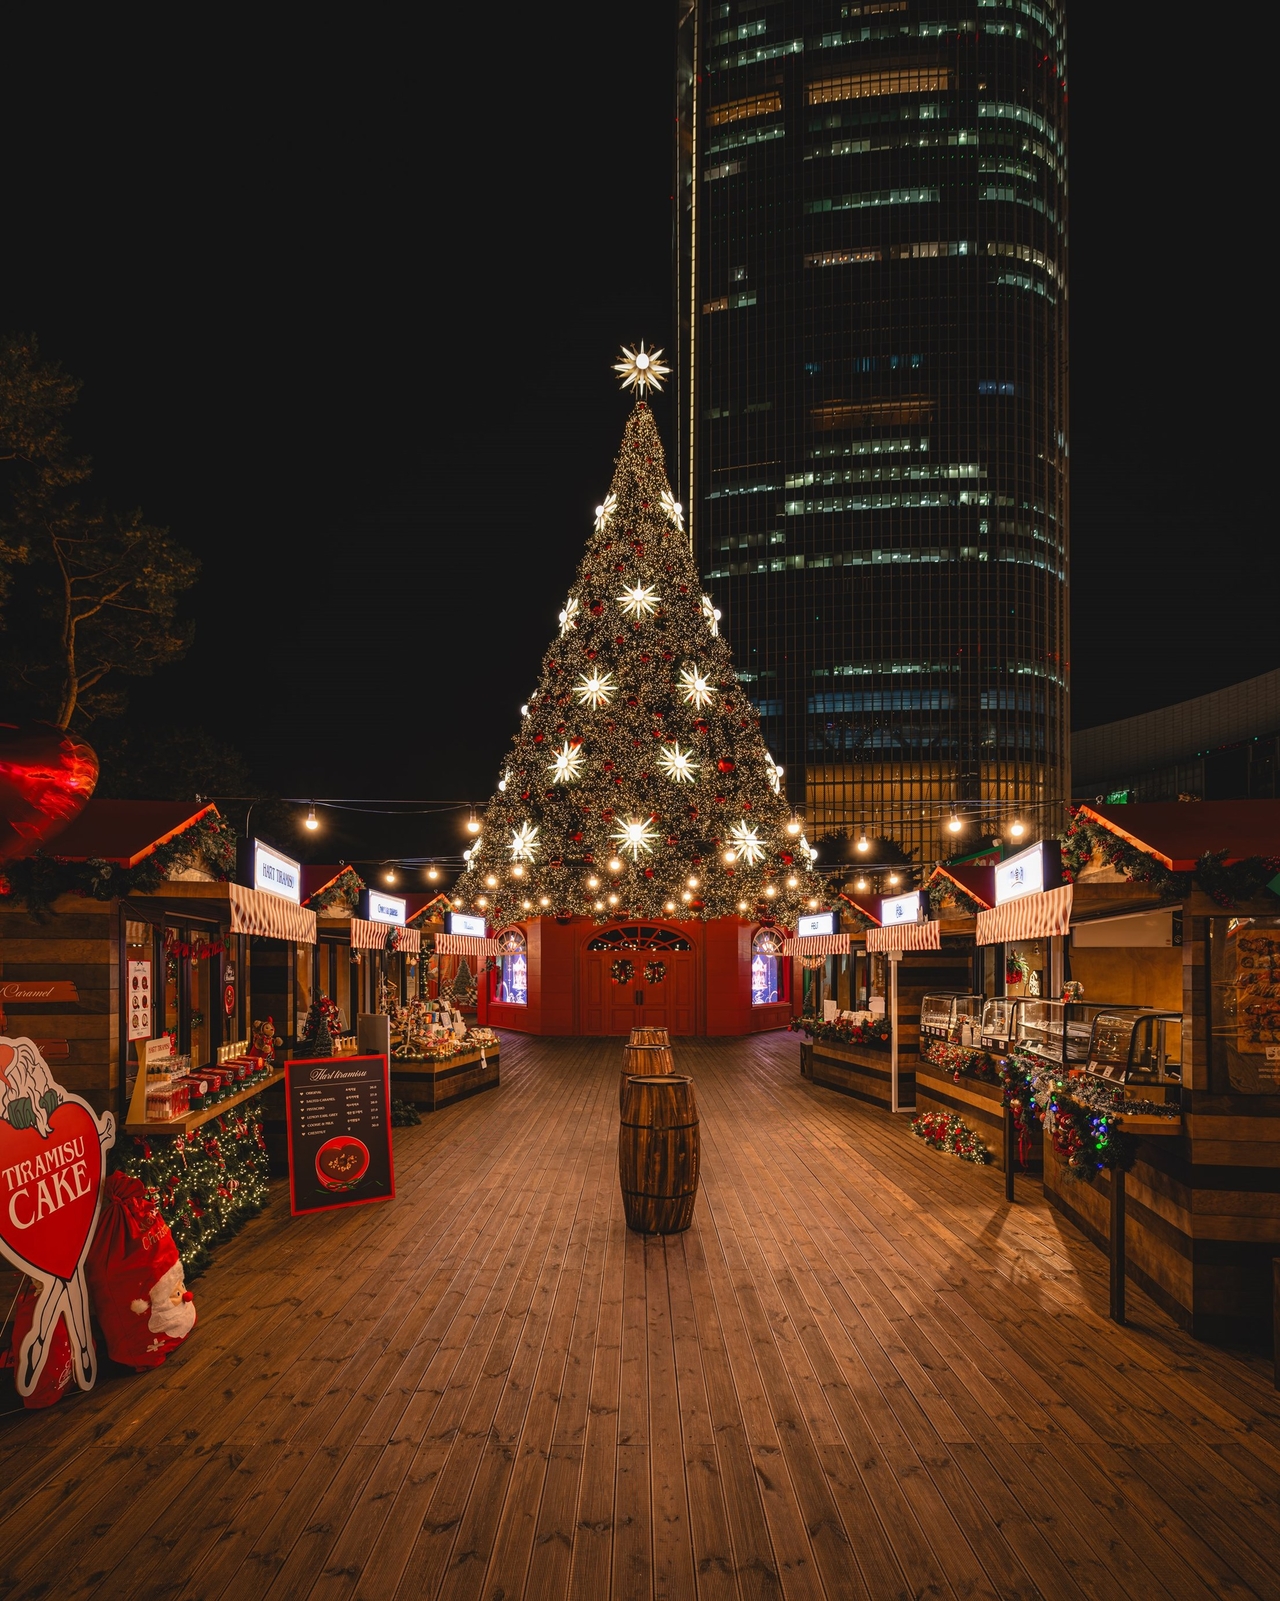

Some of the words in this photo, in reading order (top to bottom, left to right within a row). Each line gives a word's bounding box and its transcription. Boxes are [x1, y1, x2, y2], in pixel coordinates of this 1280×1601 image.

[262, 862, 275, 881] HART
[3, 983, 55, 998] Caramel
[2, 1135, 86, 1192] TIRAMISU
[9, 1159, 92, 1230] CAKE
